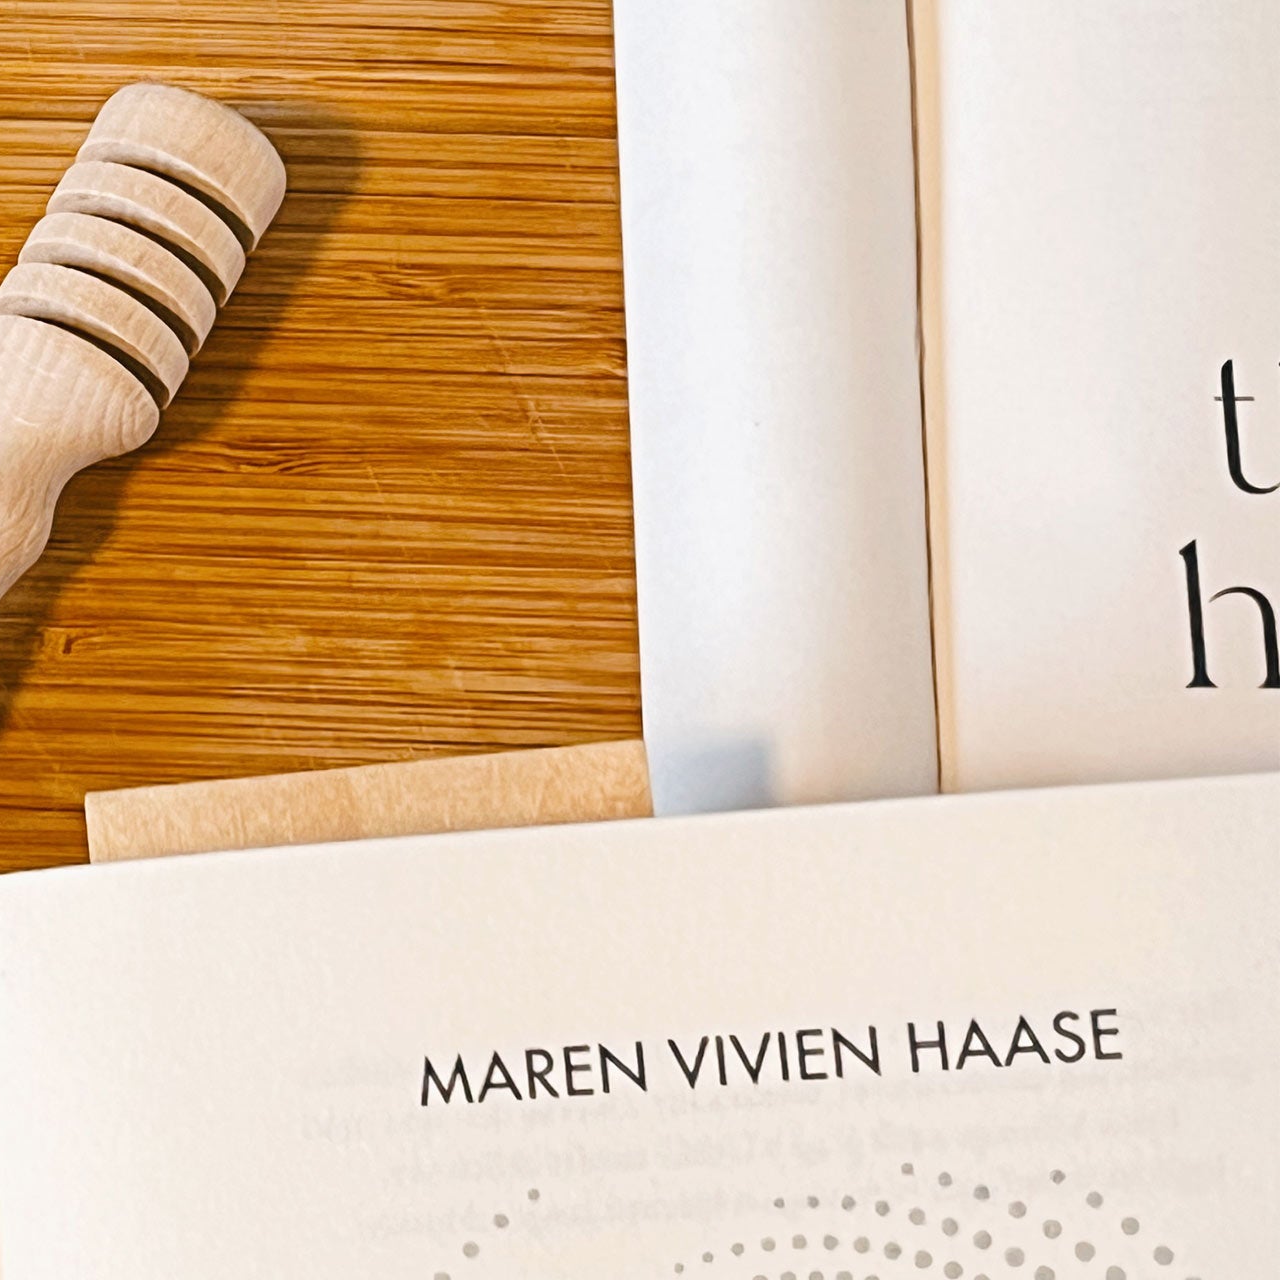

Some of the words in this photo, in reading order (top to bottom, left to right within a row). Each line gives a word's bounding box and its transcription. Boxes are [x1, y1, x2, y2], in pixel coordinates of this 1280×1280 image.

[421, 1041, 647, 1106] MAREN
[667, 1026, 881, 1089] VIVIEN
[907, 1009, 1123, 1073] HAASE
